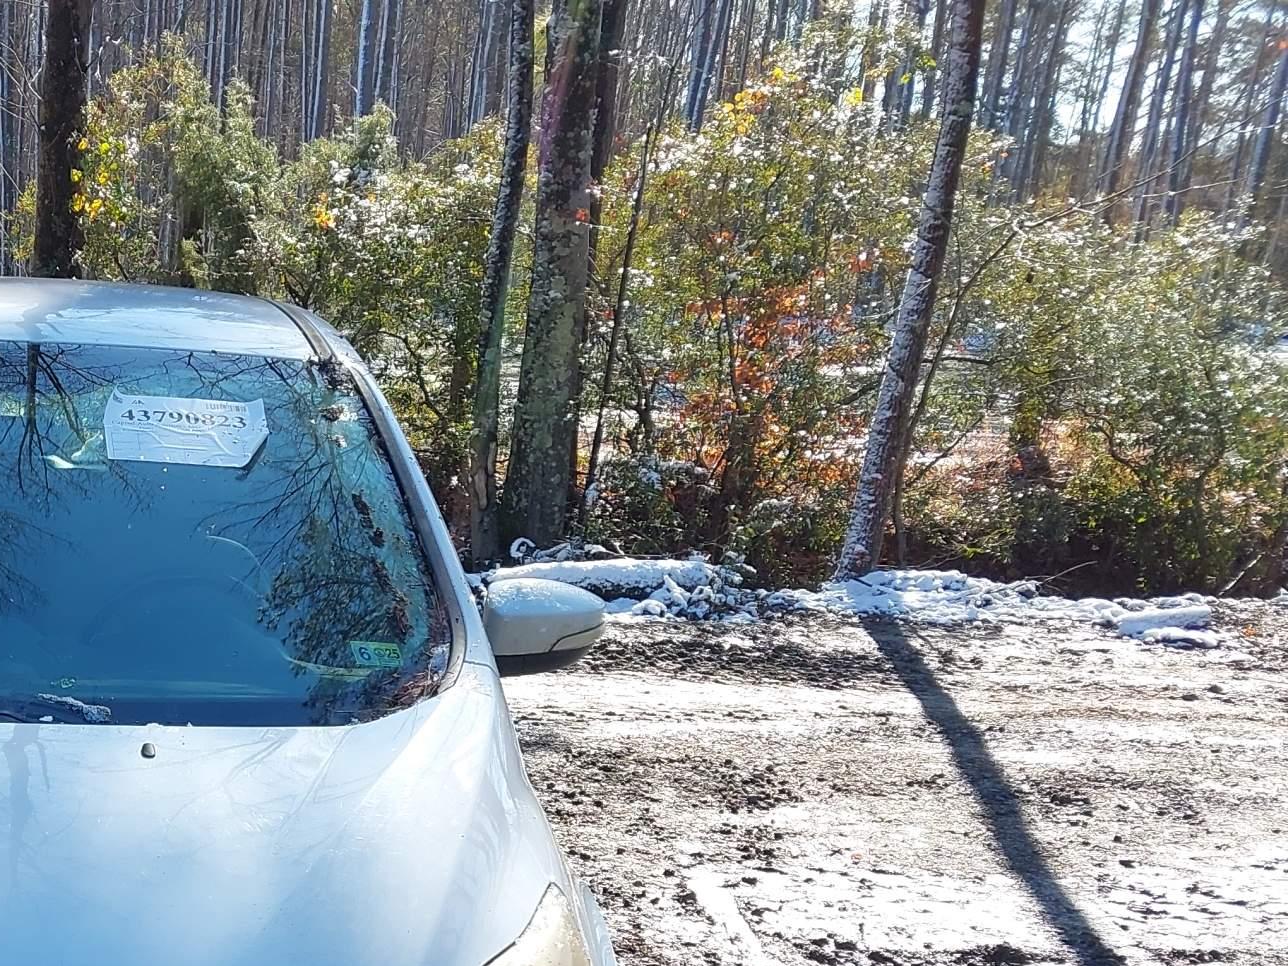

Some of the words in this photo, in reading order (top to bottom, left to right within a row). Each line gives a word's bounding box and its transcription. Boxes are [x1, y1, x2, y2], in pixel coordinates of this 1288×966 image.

[120, 408, 248, 430] 43790823
[358, 646, 371, 661] 6
[384, 648, 401, 660] 25
